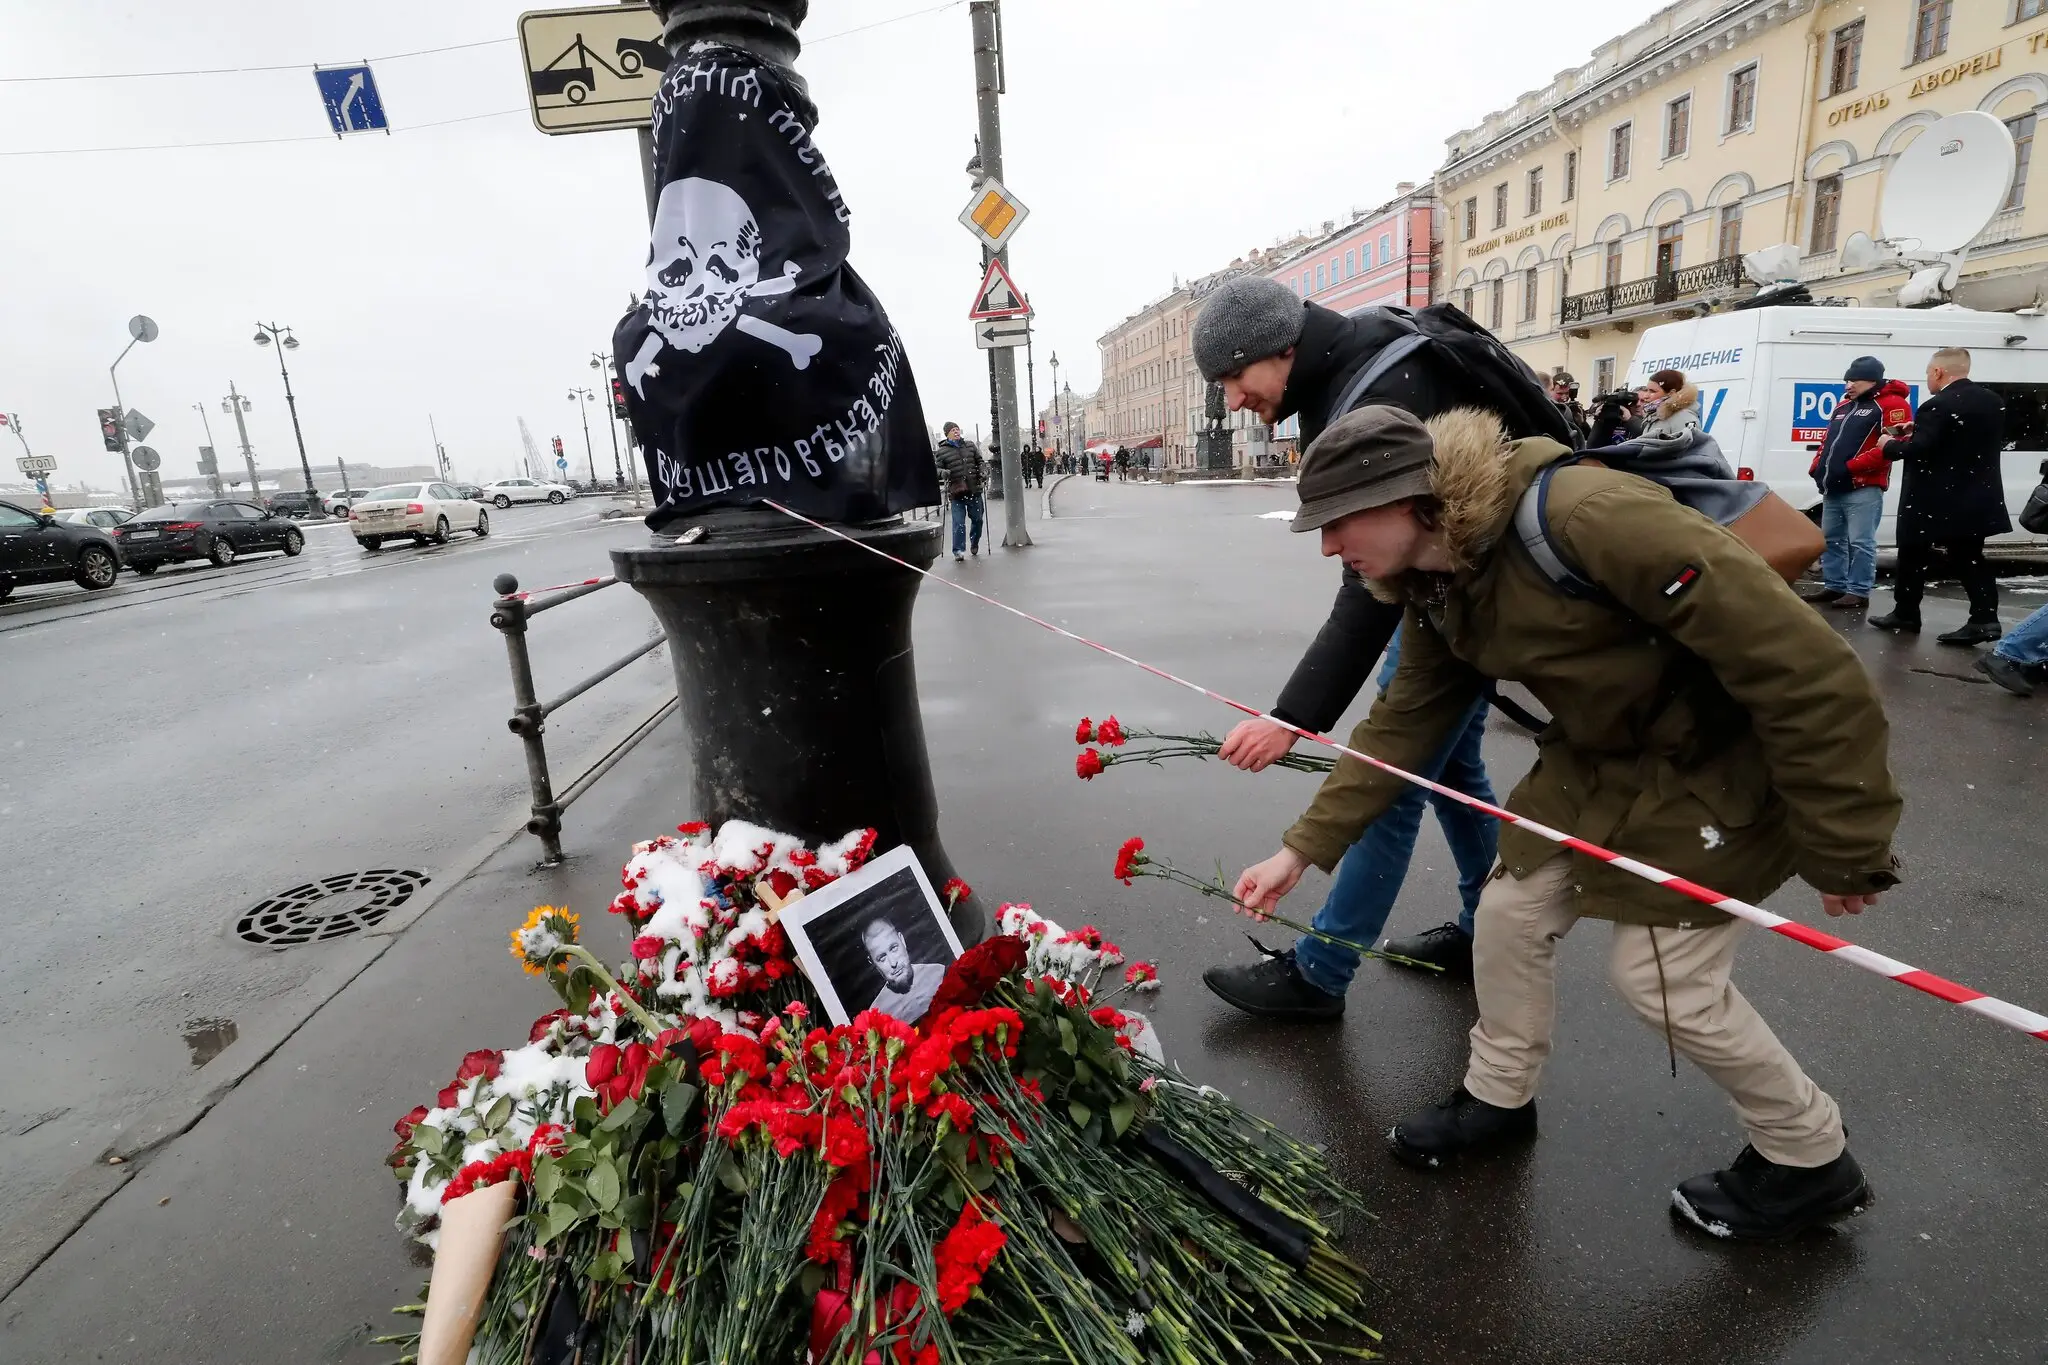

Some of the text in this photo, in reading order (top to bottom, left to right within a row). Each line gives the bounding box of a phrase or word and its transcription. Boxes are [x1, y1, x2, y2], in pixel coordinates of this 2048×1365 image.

[1828, 93, 1889, 127] ОТЕЛЬ
[1908, 47, 2001, 98] ДВОРЕЦ
[1467, 212, 1569, 258] TREZZINI PALACE HOTEL
[1642, 348, 1743, 374] ТЕЛЕВИДЕНИЕ
[22, 458, 52, 470] СТОП
